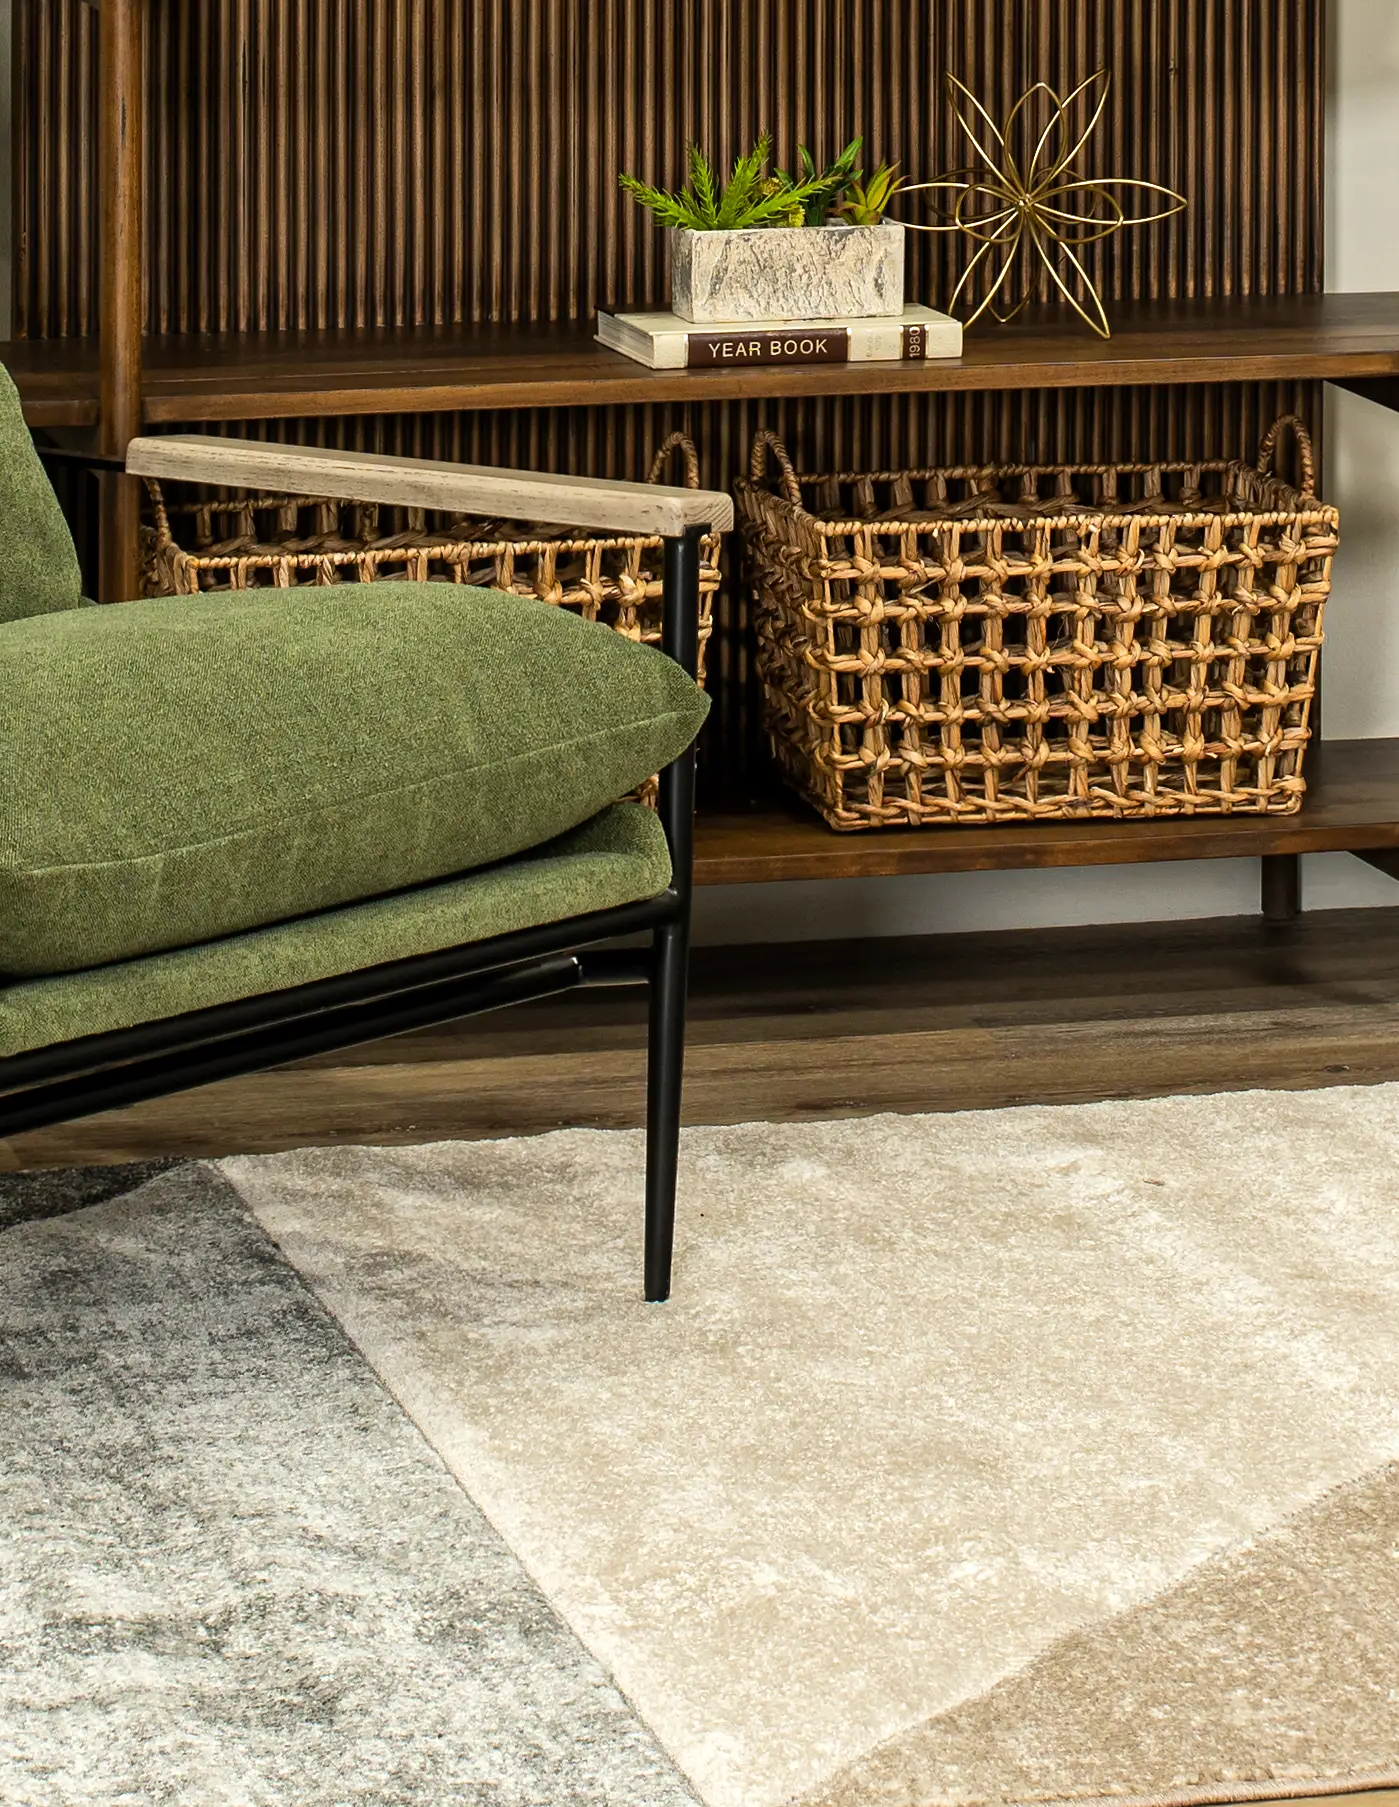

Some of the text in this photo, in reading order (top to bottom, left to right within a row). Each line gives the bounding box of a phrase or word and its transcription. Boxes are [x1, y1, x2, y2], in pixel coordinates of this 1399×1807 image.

[707, 338, 828, 358] YEAR BOOK
[909, 325, 921, 358] 1980
